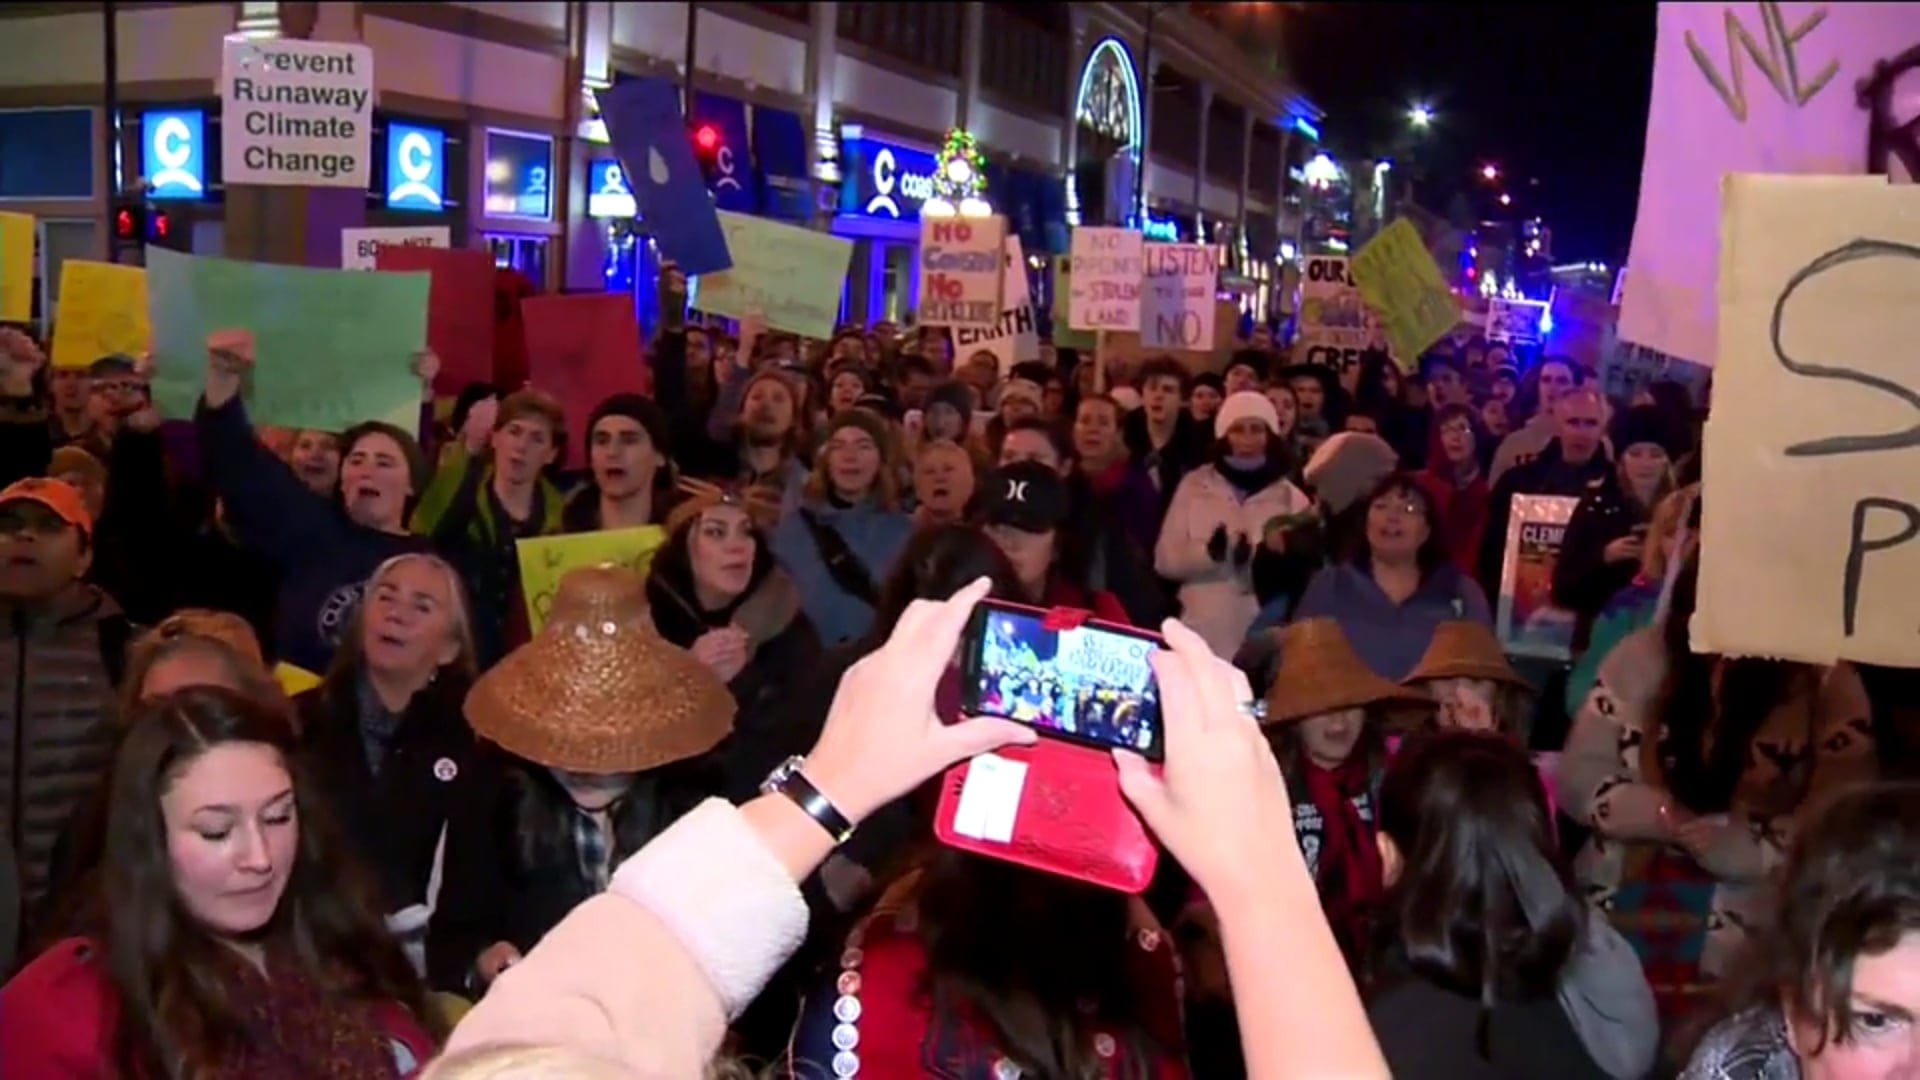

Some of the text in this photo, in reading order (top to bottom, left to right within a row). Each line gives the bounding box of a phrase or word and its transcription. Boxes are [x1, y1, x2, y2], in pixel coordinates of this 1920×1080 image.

[242, 47, 355, 75] revent
[233, 78, 368, 113] Runaway
[245, 111, 355, 138] Climate
[244, 146, 355, 178] Change
[1146, 247, 1217, 277] LISTEN
[1308, 259, 1345, 282] OUR
[1156, 311, 1202, 344] NO
